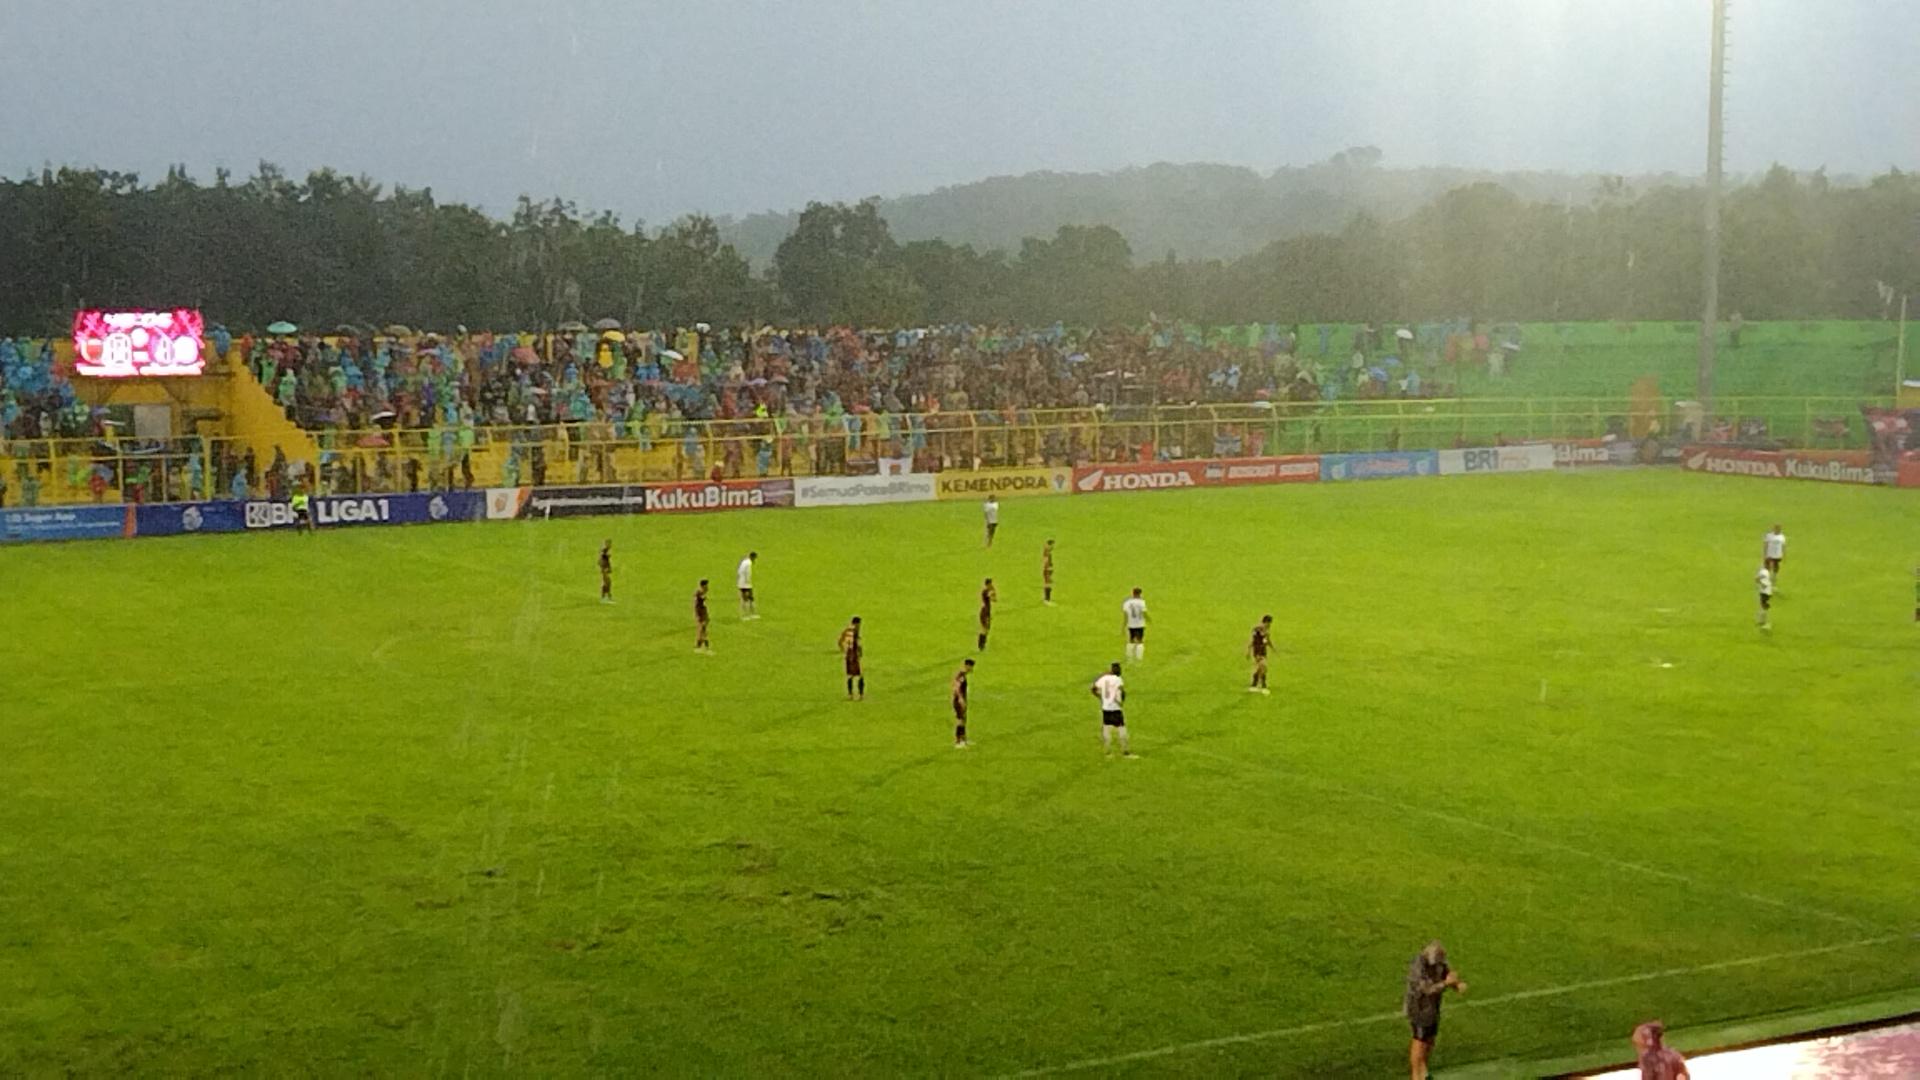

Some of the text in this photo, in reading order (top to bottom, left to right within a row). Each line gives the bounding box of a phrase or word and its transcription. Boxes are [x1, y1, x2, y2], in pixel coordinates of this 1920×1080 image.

[1707, 458, 1782, 476] HONDA
[1786, 459, 1874, 483] KukuBima
[941, 476, 1048, 493] KEMENPORA
[1104, 471, 1195, 490] HONDA
[645, 485, 763, 509] KukuBima
[317, 499, 389, 522] LIGA1
